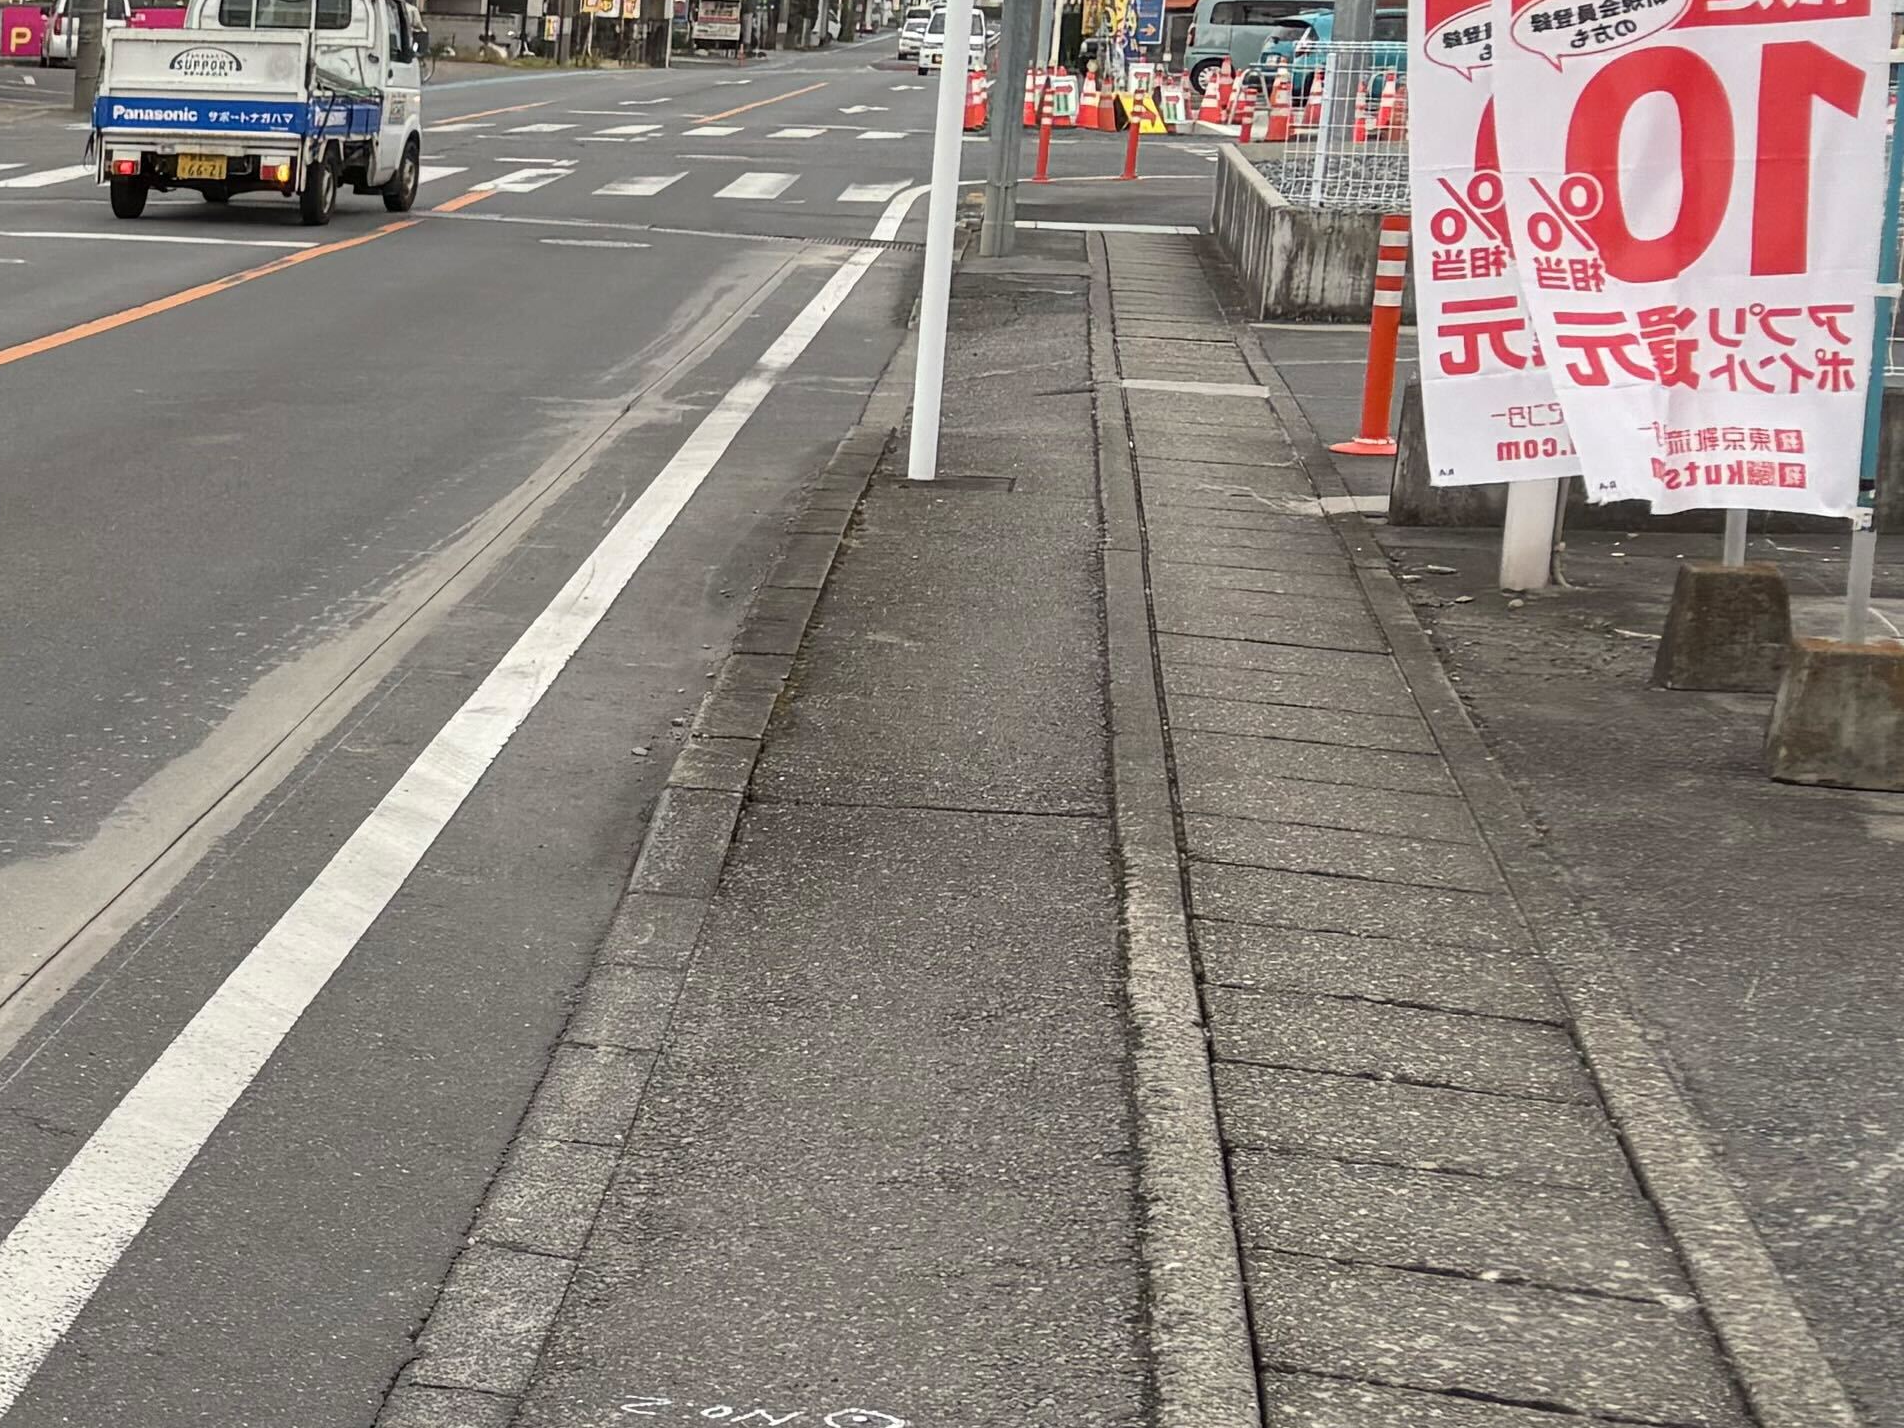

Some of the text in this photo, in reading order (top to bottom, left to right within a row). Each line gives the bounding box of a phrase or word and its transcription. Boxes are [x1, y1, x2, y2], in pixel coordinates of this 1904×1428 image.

[9, 27, 31, 53] P
[177, 59, 234, 71] SUPPORT
[113, 105, 198, 122] Panasonic
[208, 110, 294, 125] サポートナガハマ
